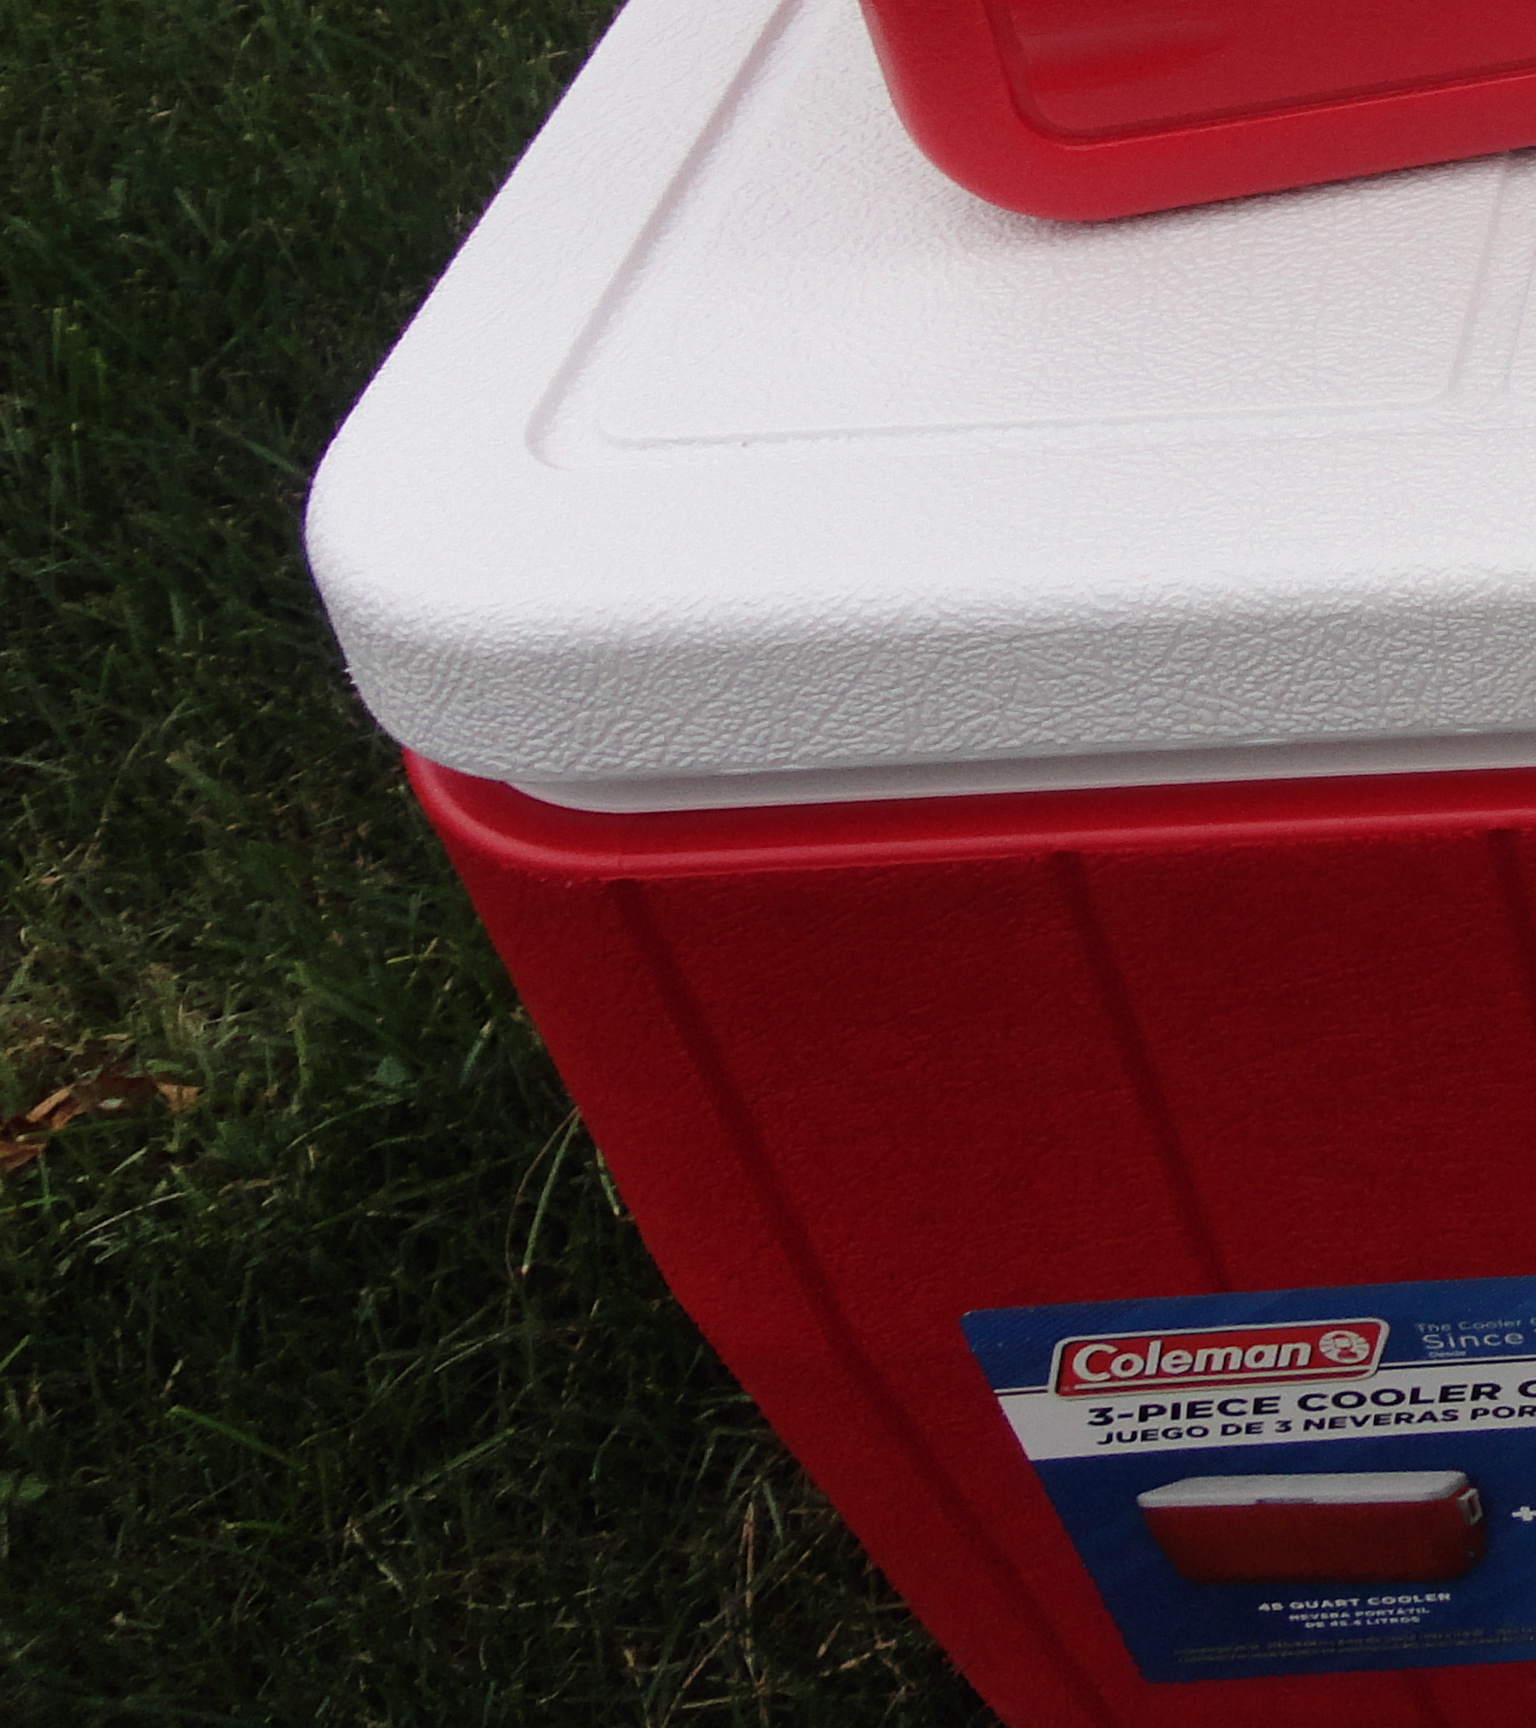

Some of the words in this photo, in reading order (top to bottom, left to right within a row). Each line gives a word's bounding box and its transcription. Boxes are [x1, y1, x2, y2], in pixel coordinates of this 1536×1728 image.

[1422, 1331, 1524, 1350] Since
[1072, 1340, 1312, 1382] Coleman
[1088, 1396, 1281, 1426] 3-PIECE
[1297, 1382, 1501, 1412] COOLER
[1097, 1425, 1209, 1445] JUEGO
[1221, 1422, 1264, 1437] DE
[1275, 1419, 1293, 1434] 3
[1303, 1408, 1459, 1432] NEVERAS
[1289, 1597, 1360, 1611] QUART
[1367, 1592, 1451, 1606] COOLER
